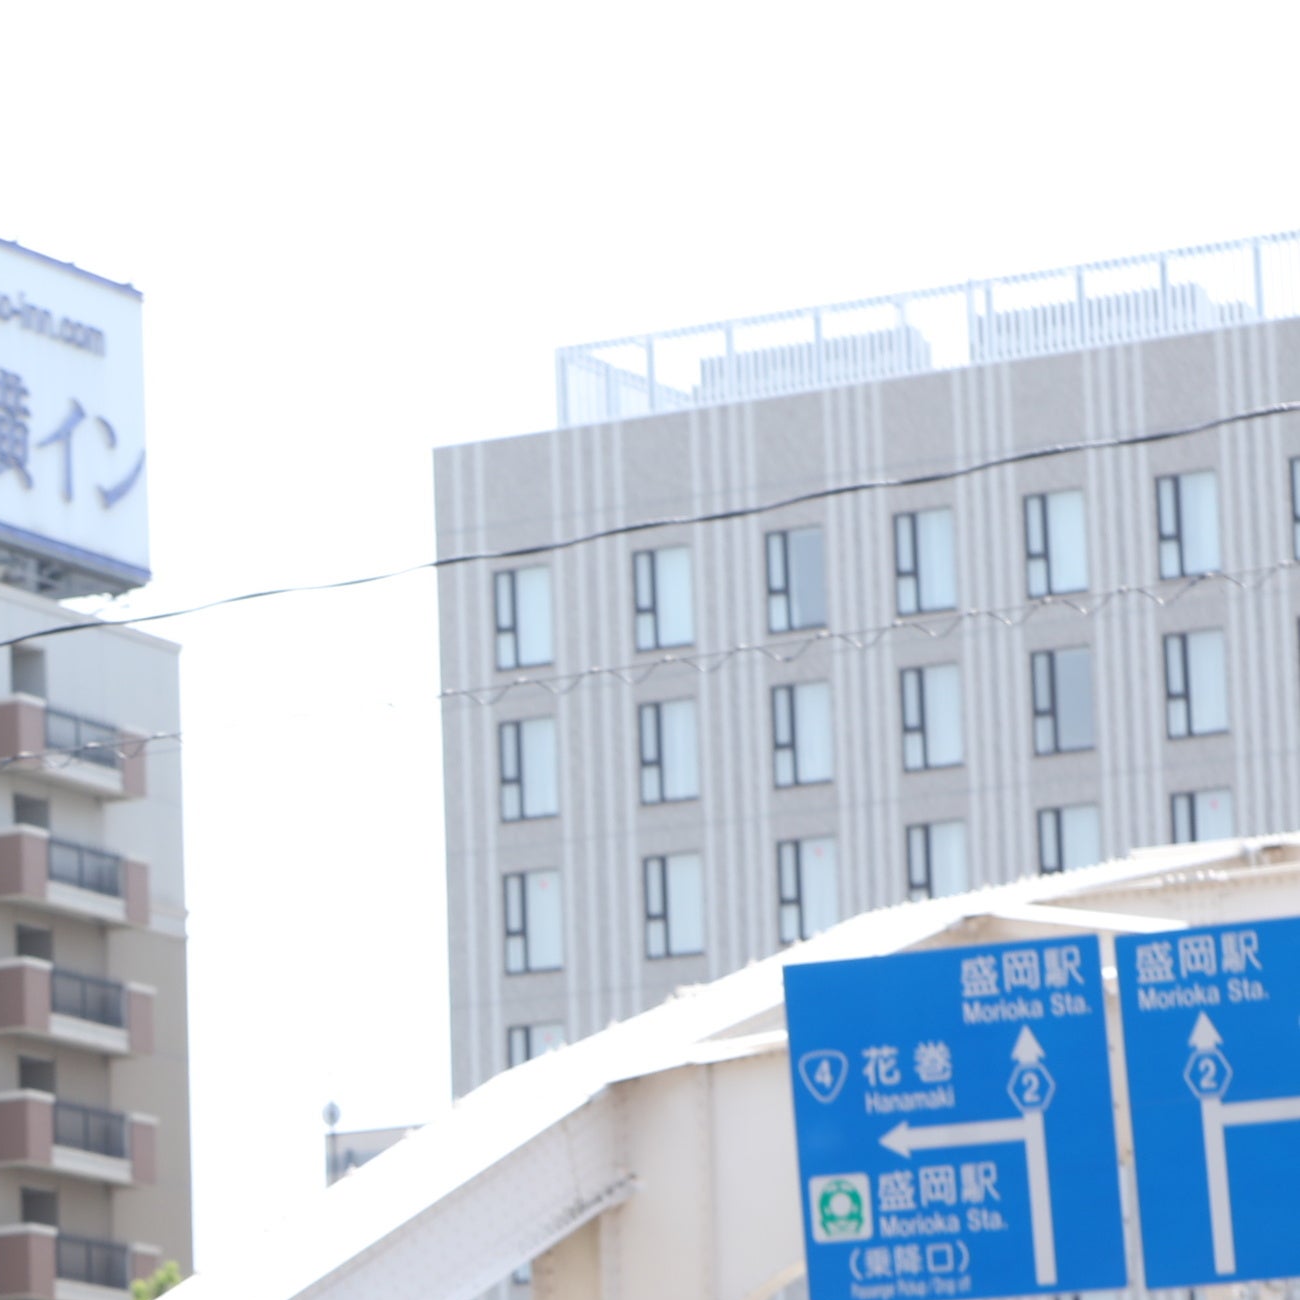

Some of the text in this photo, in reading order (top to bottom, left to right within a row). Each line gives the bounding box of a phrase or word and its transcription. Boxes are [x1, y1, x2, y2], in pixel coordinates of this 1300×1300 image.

[961, 945, 1085, 998] 盛岡駅
[1136, 930, 1262, 984] 盛岡駅
[962, 991, 1092, 1025] Morioka Sta.
[1138, 976, 1270, 1012] Morioka Sta.
[813, 1058, 834, 1089] 4
[861, 1040, 952, 1087] 花巻
[1199, 1057, 1217, 1090] 2
[864, 1083, 956, 1115] Hanamaki
[1021, 1071, 1041, 1103] 2
[878, 1160, 1001, 1213] 盛岡駅
[879, 1206, 1009, 1239] Morioka Sta.
